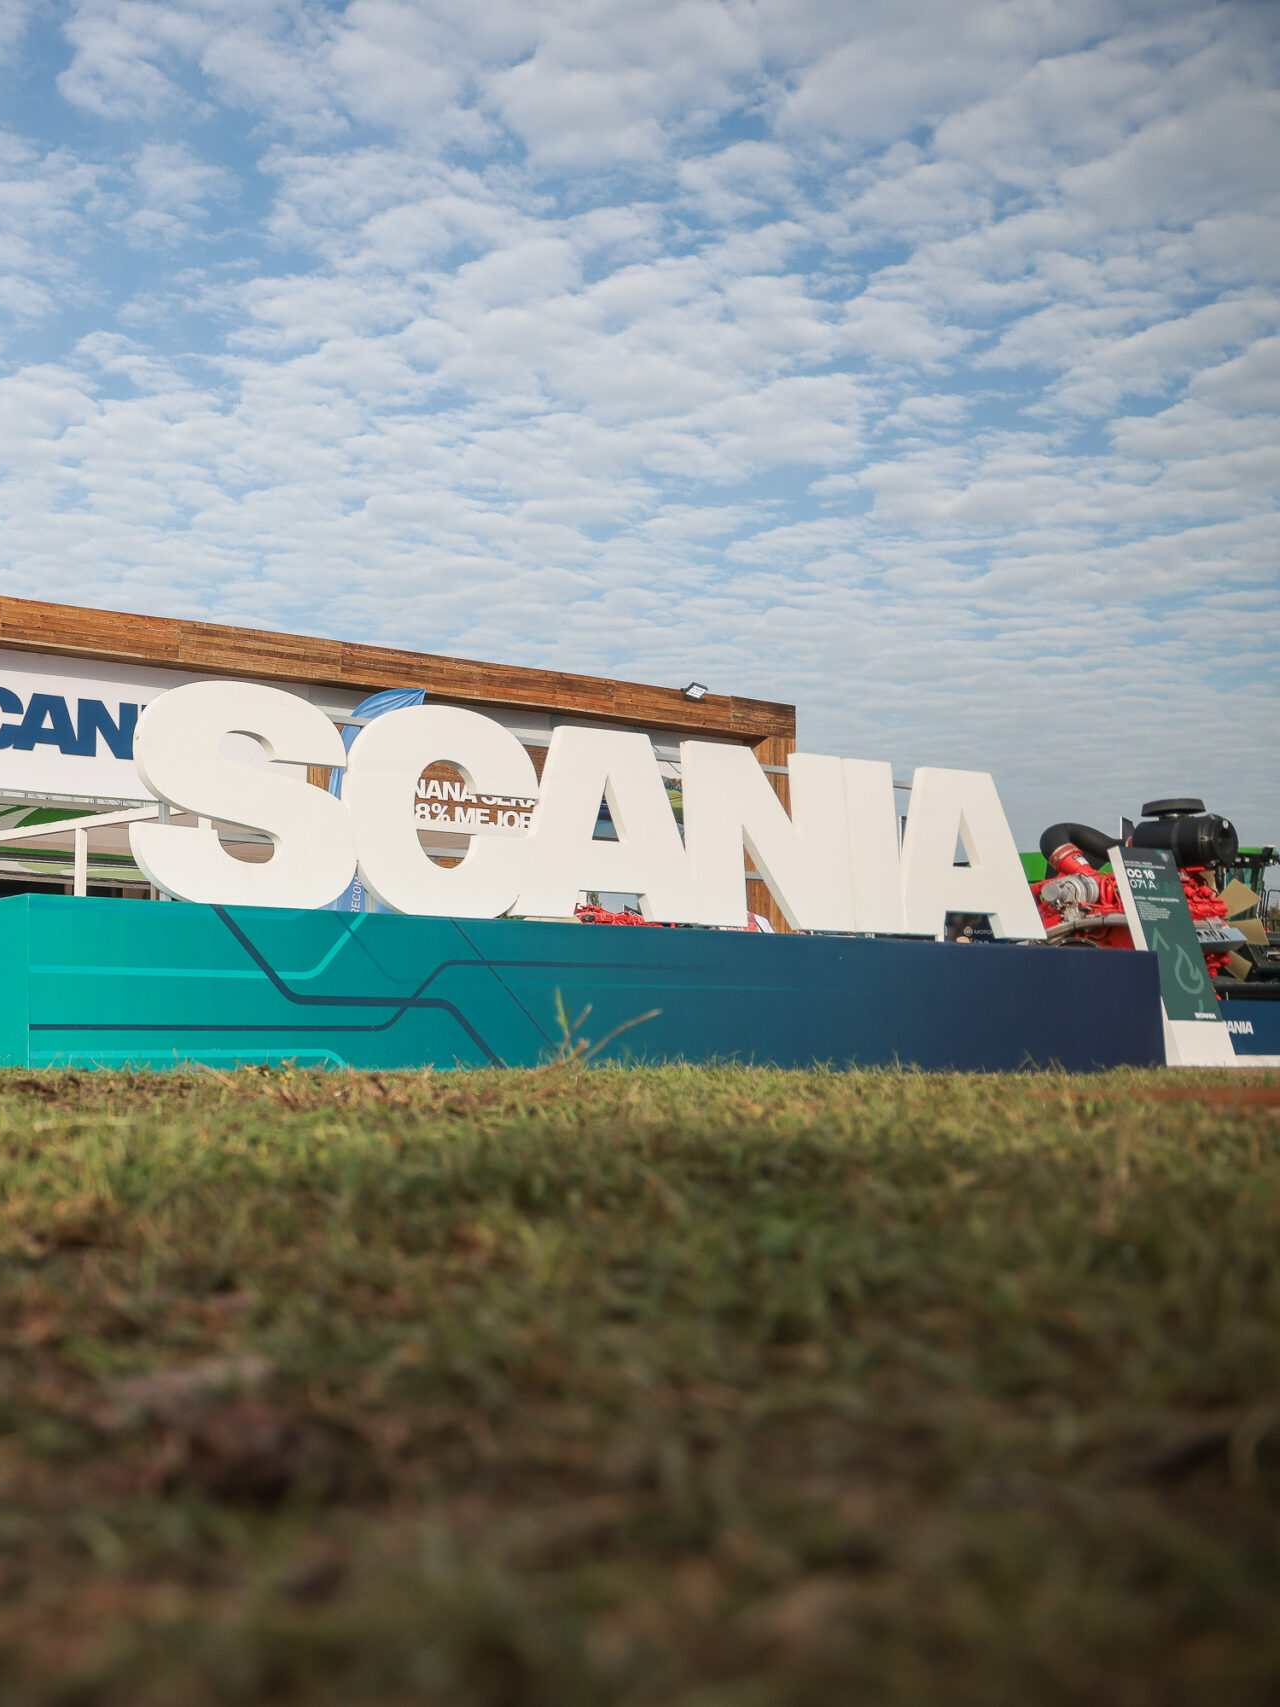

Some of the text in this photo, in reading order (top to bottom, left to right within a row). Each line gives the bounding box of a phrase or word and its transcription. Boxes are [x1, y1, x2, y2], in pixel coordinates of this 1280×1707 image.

[129, 680, 1047, 942] SCANIA
[1143, 870, 1156, 880] 16
[973, 928, 992, 936] MOTO
[1226, 1021, 1254, 1034] ANIA
